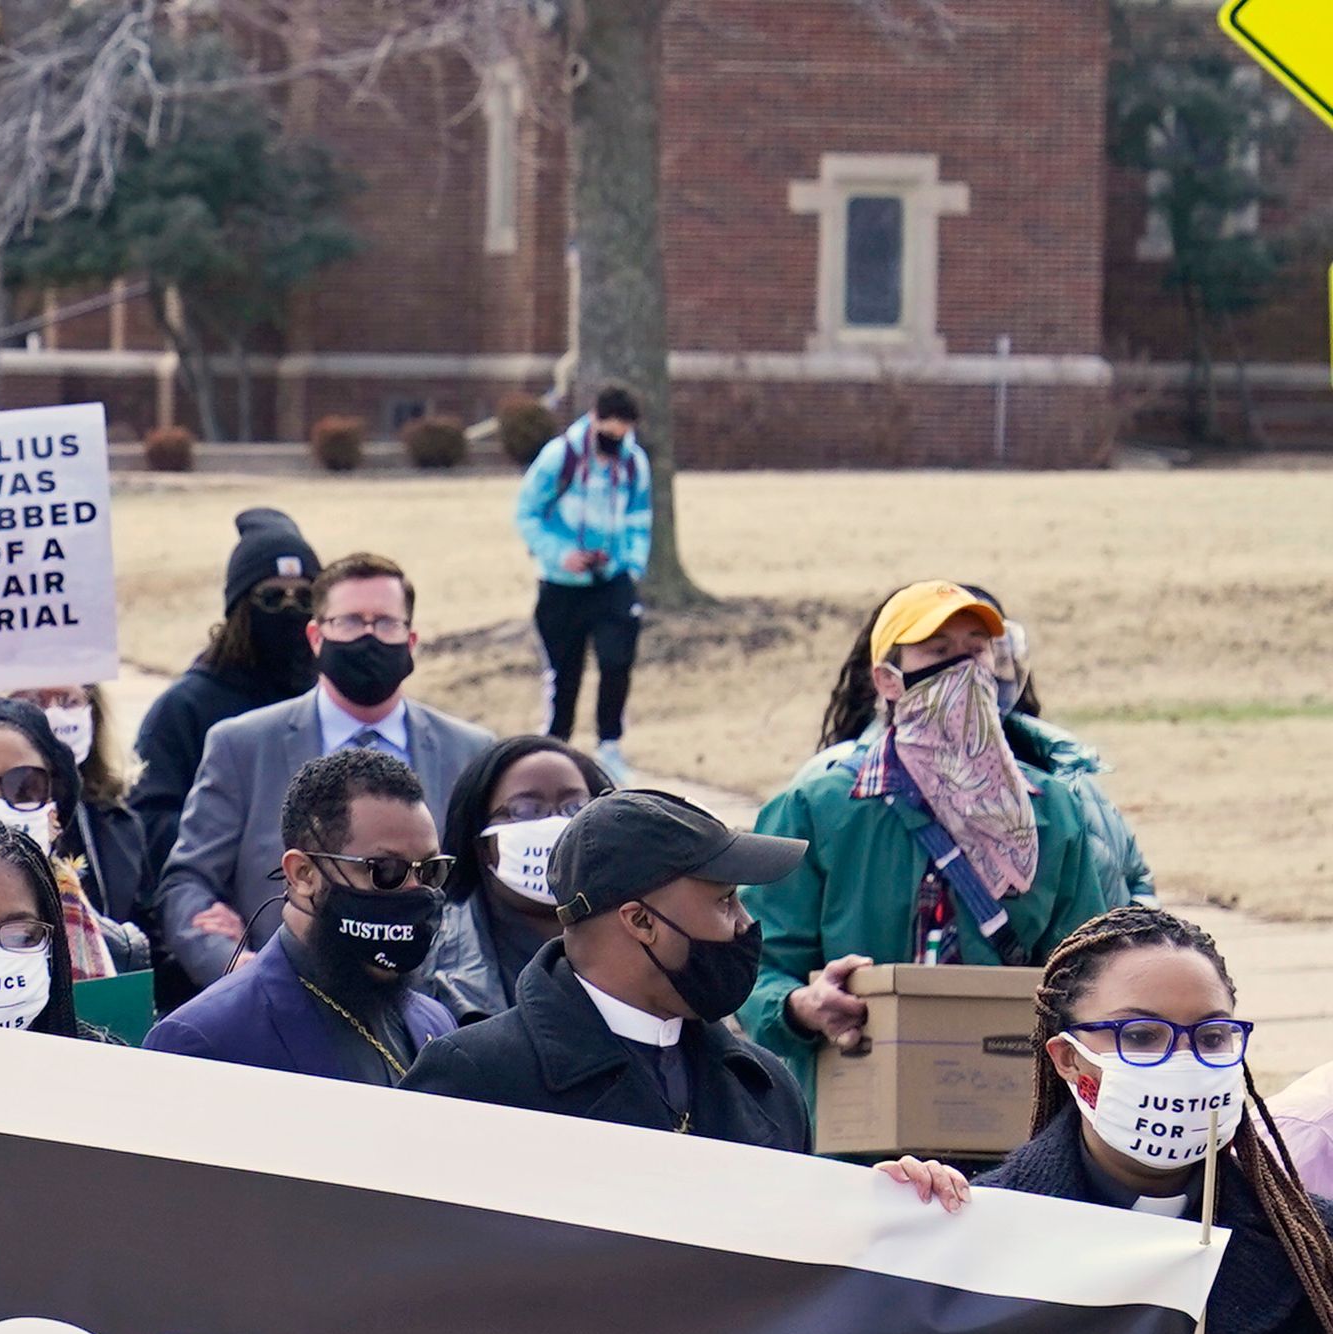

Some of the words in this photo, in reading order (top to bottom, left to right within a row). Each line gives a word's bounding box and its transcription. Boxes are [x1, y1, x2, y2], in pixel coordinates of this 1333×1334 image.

[42, 538, 66, 562] A
[339, 918, 415, 942] JUSTICE
[1138, 1092, 1231, 1113] JUSTICE
[1134, 1117, 1185, 1139] FOR
